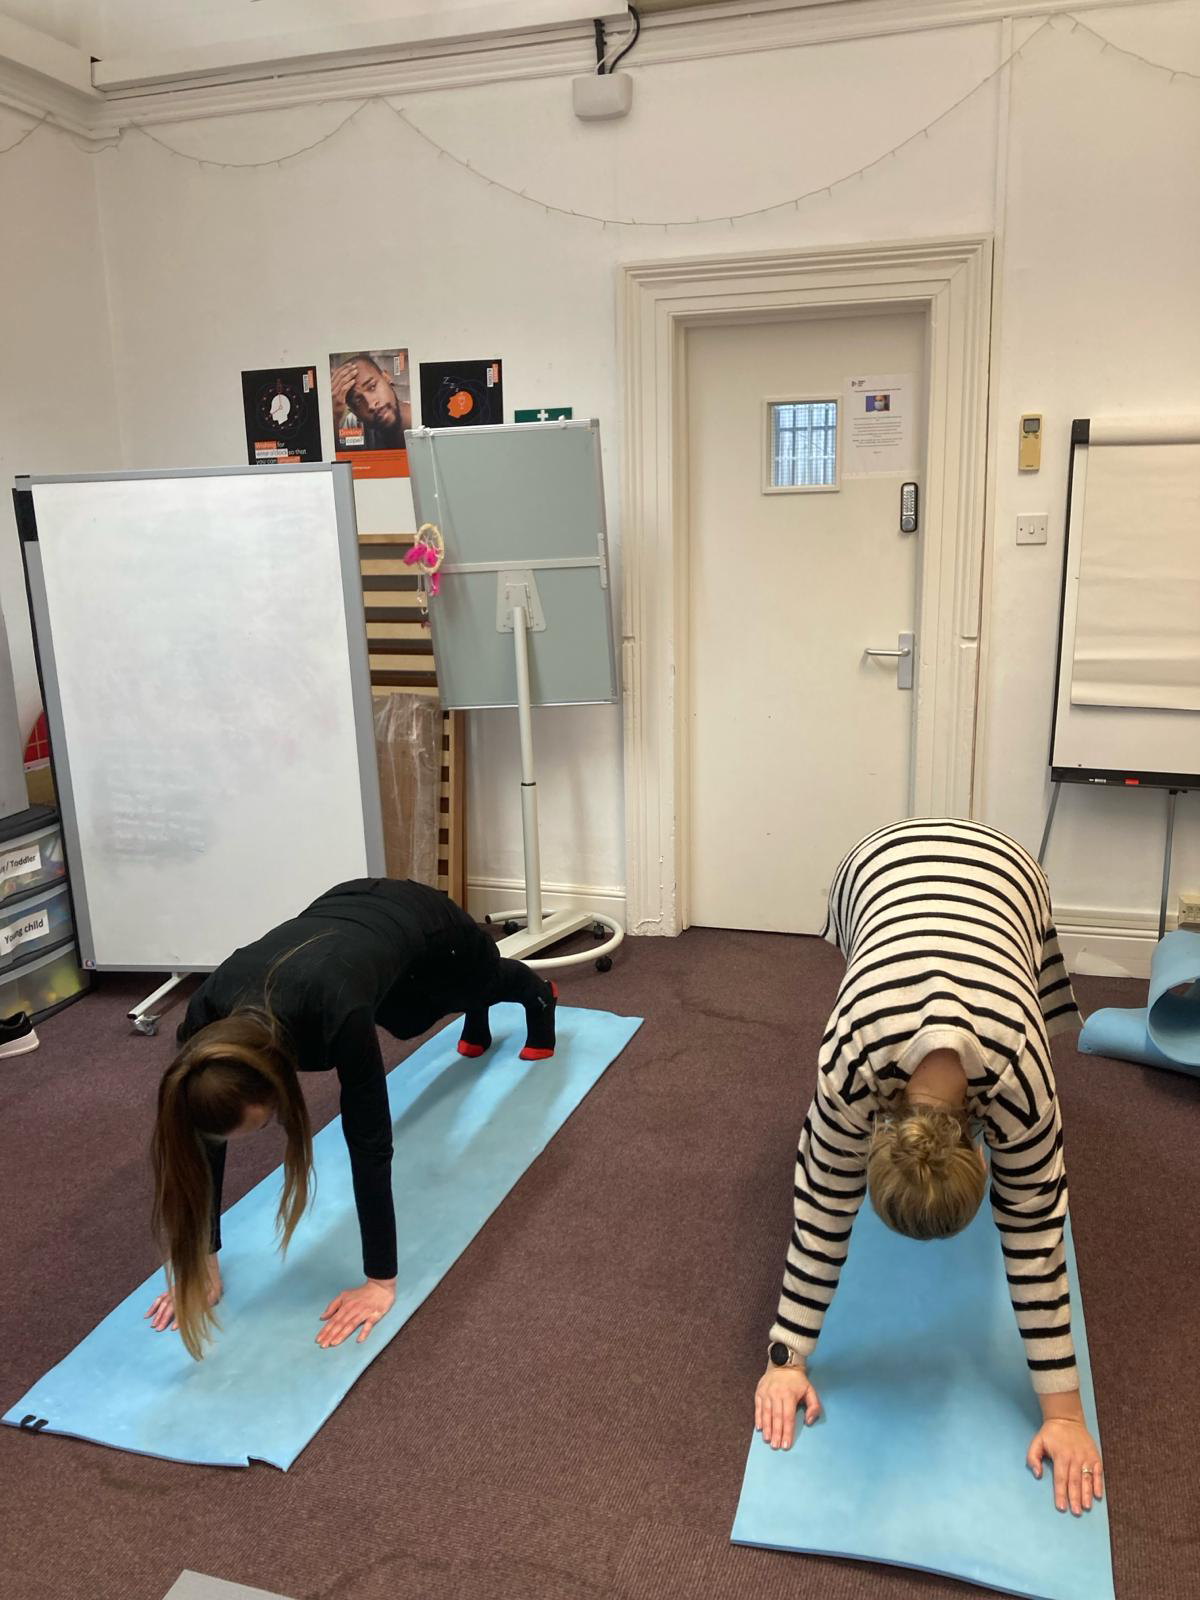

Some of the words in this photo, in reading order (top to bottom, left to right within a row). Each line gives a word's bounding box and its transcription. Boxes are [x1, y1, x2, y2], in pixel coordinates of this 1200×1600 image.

[10, 855, 36, 868] Toddler
[4, 928, 23, 944] Young
[24, 919, 44, 933] child
